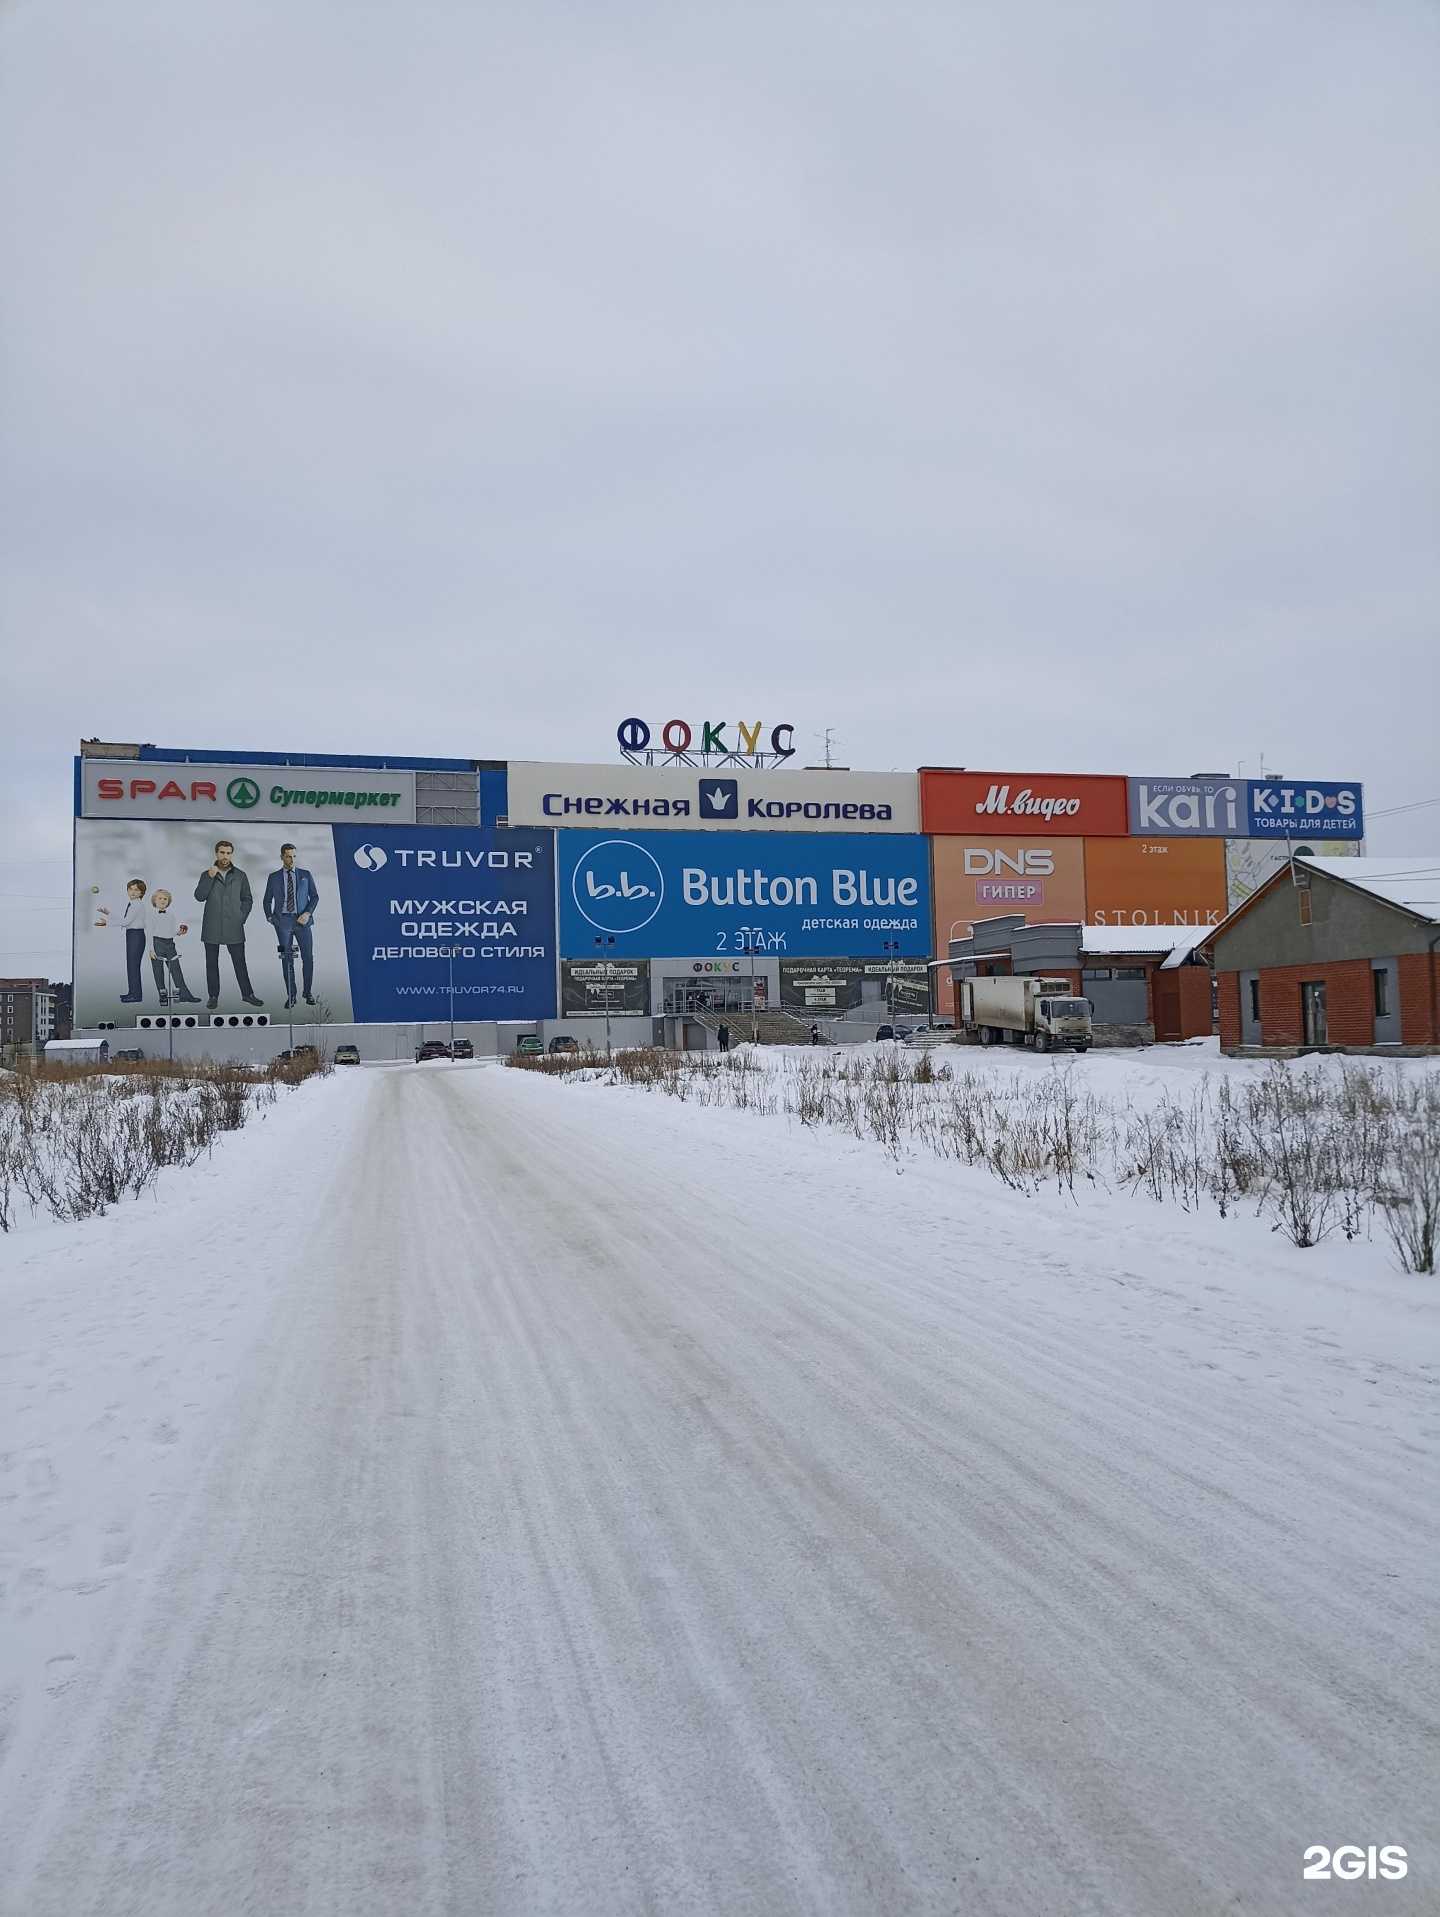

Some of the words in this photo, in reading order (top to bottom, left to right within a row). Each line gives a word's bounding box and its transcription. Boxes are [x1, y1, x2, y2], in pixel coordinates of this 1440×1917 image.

[617, 717, 796, 756] ФОКУС
[97, 778, 217, 801] SPAR
[270, 785, 402, 809] Супермаркет
[1153, 785, 1174, 793] ЕСЛИ
[542, 793, 691, 817] Снежная
[747, 798, 893, 821] Королева
[975, 785, 1081, 821] М.видео
[1139, 785, 1237, 829] kari
[1255, 818, 1298, 829] ТОВАРЫ
[1300, 818, 1321, 830] ДЛЯ
[1323, 818, 1357, 830] ДЕТЕЙ
[963, 848, 1056, 876] DNS
[682, 867, 818, 906] Button
[831, 868, 919, 906] Blue
[983, 885, 1036, 899] ГИПЕР
[390, 899, 528, 915] МУЖСКАЯ
[801, 917, 859, 931] детская
[862, 917, 918, 931] одежда
[1094, 909, 1220, 926] STOLNIK
[401, 921, 518, 939] ОДЕЖДА
[715, 931, 728, 951] 2
[734, 931, 787, 951] ЭТАЖ
[372, 946, 476, 960] ДЕЛОВОГО
[480, 946, 545, 958] СТИЛЯ
[693, 962, 740, 973] ФОКУС
[396, 986, 525, 995] WWW.TRUVOR74.RU
